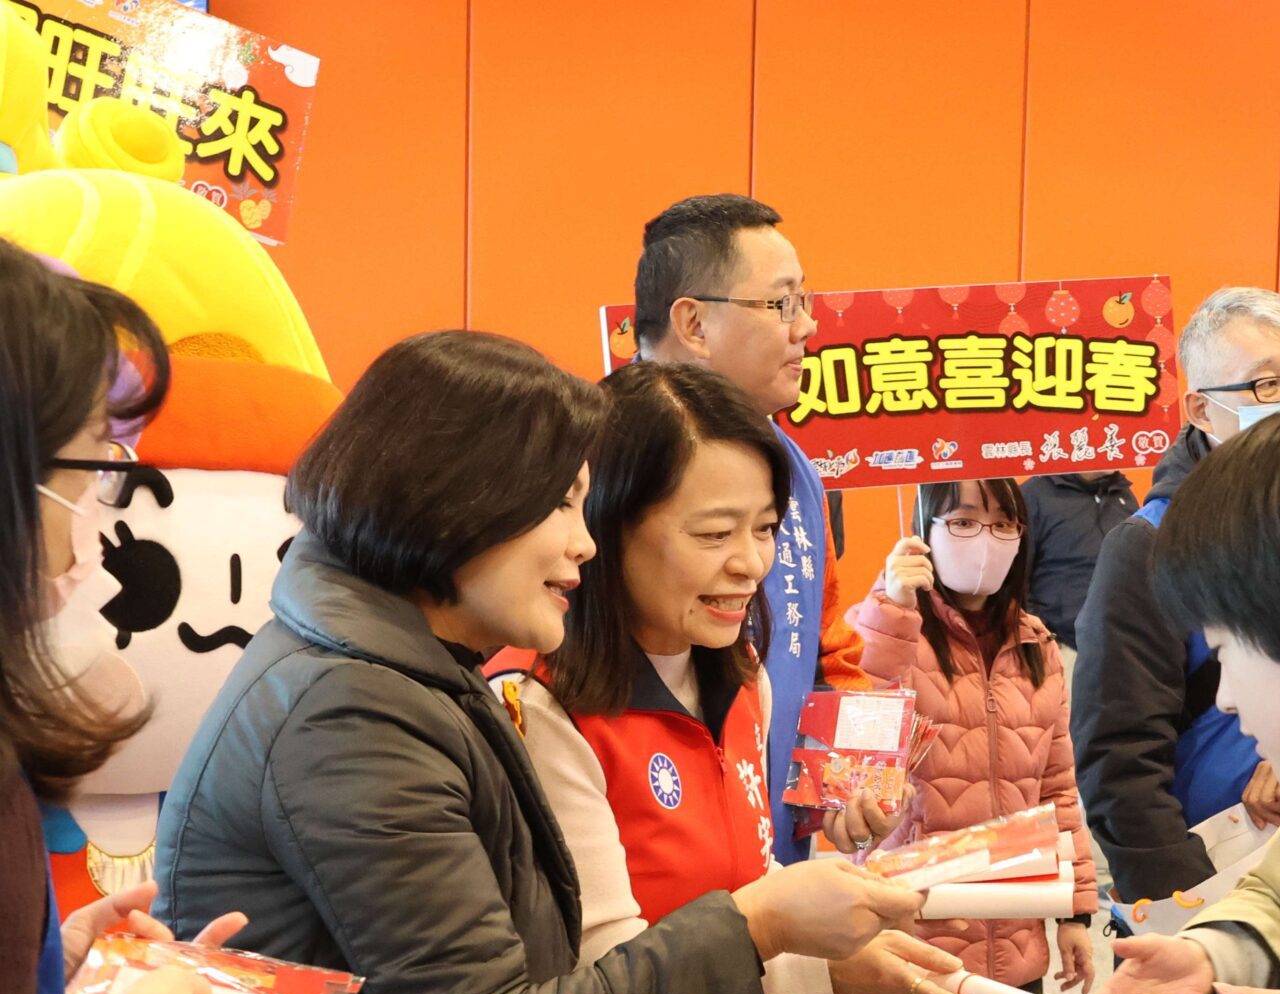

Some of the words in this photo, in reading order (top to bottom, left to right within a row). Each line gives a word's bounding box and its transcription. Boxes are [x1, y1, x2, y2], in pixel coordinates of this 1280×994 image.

[788, 334, 1160, 424] 如意喜迎春
[777, 518, 805, 659] 通工務局
